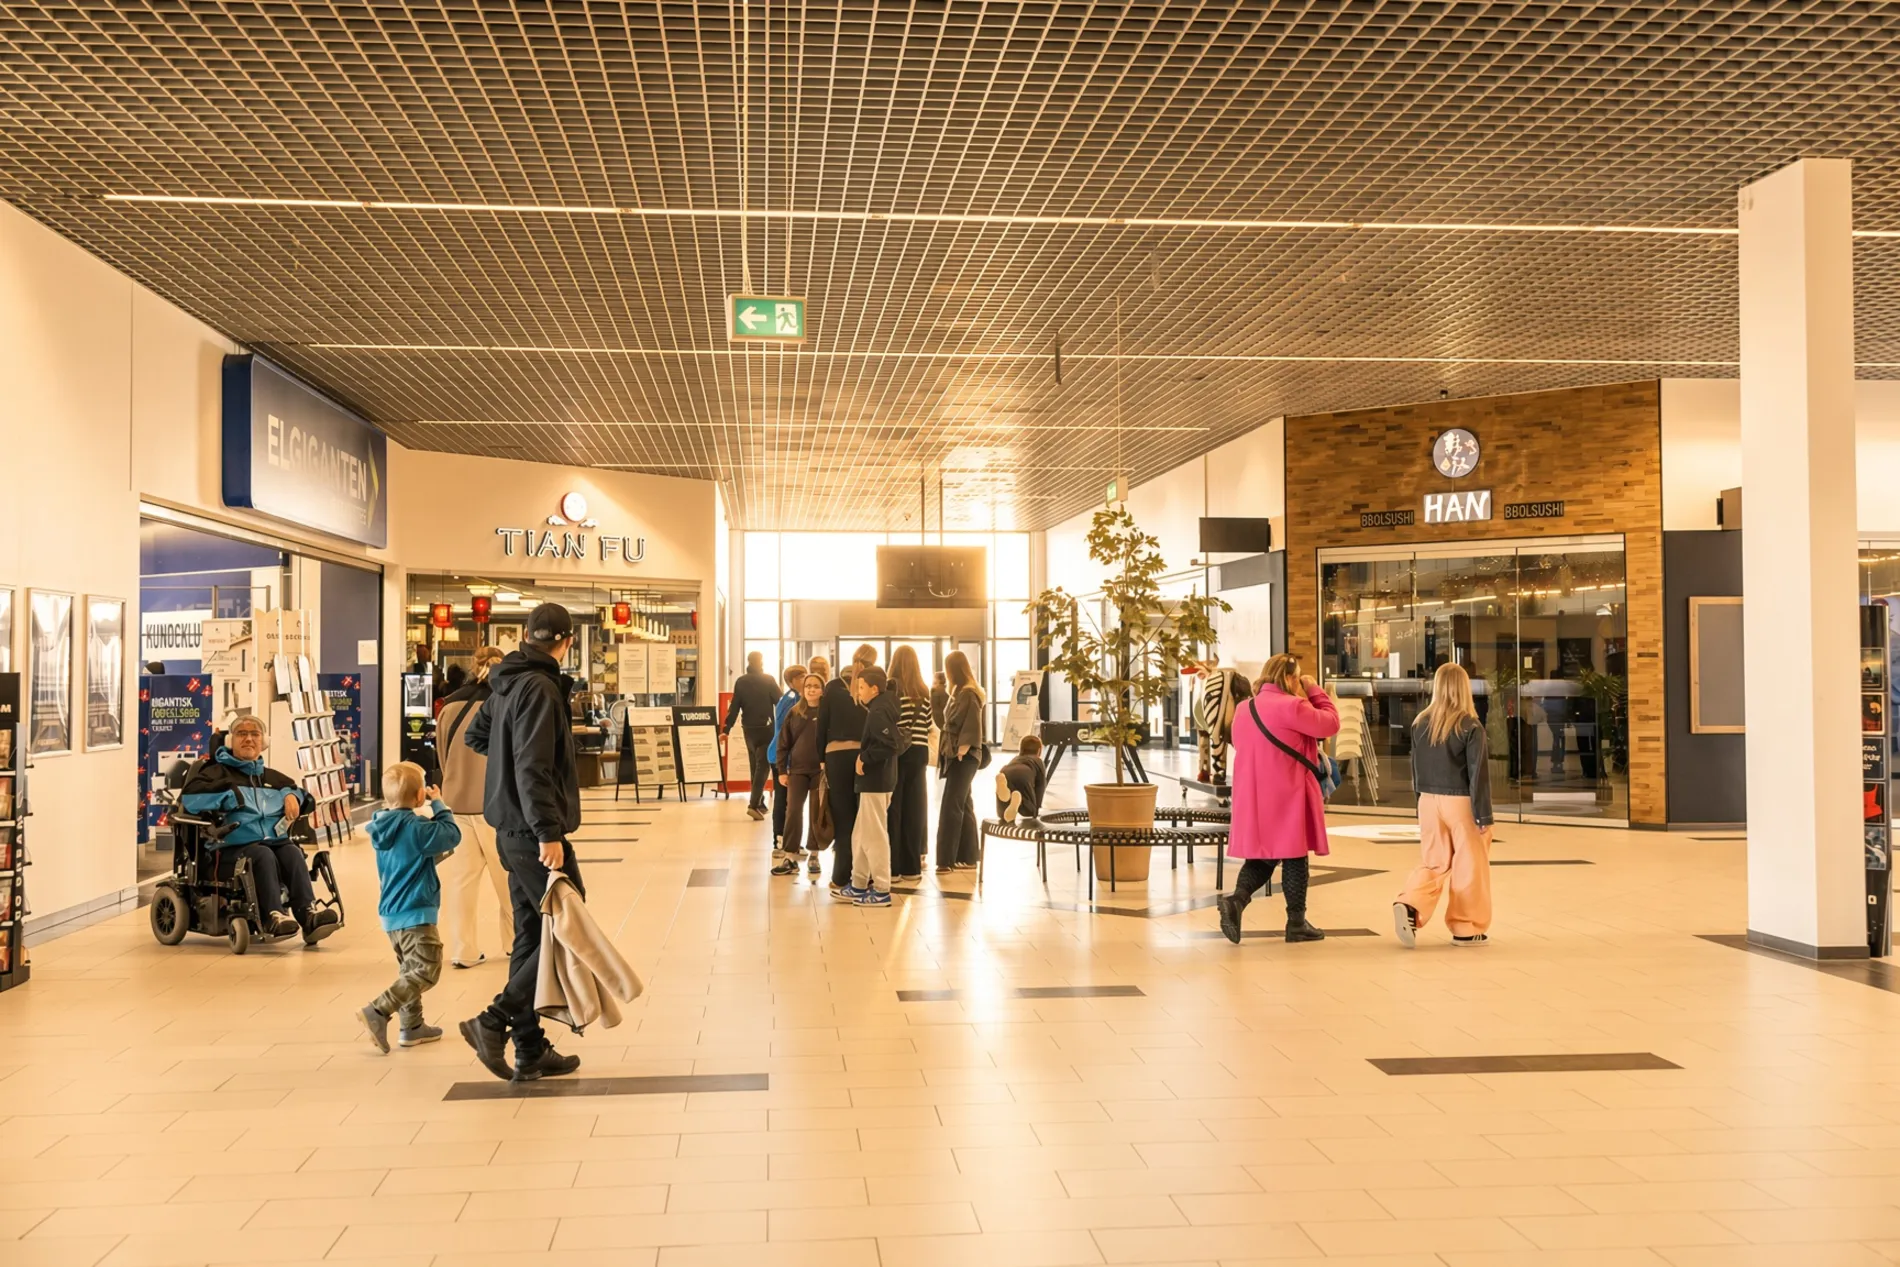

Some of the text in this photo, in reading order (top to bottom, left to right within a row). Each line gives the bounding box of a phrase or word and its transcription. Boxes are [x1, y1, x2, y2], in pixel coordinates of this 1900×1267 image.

[267, 413, 367, 502] ELGIGANTEN
[1425, 491, 1490, 523] HAN
[496, 527, 646, 563] TIAN FU
